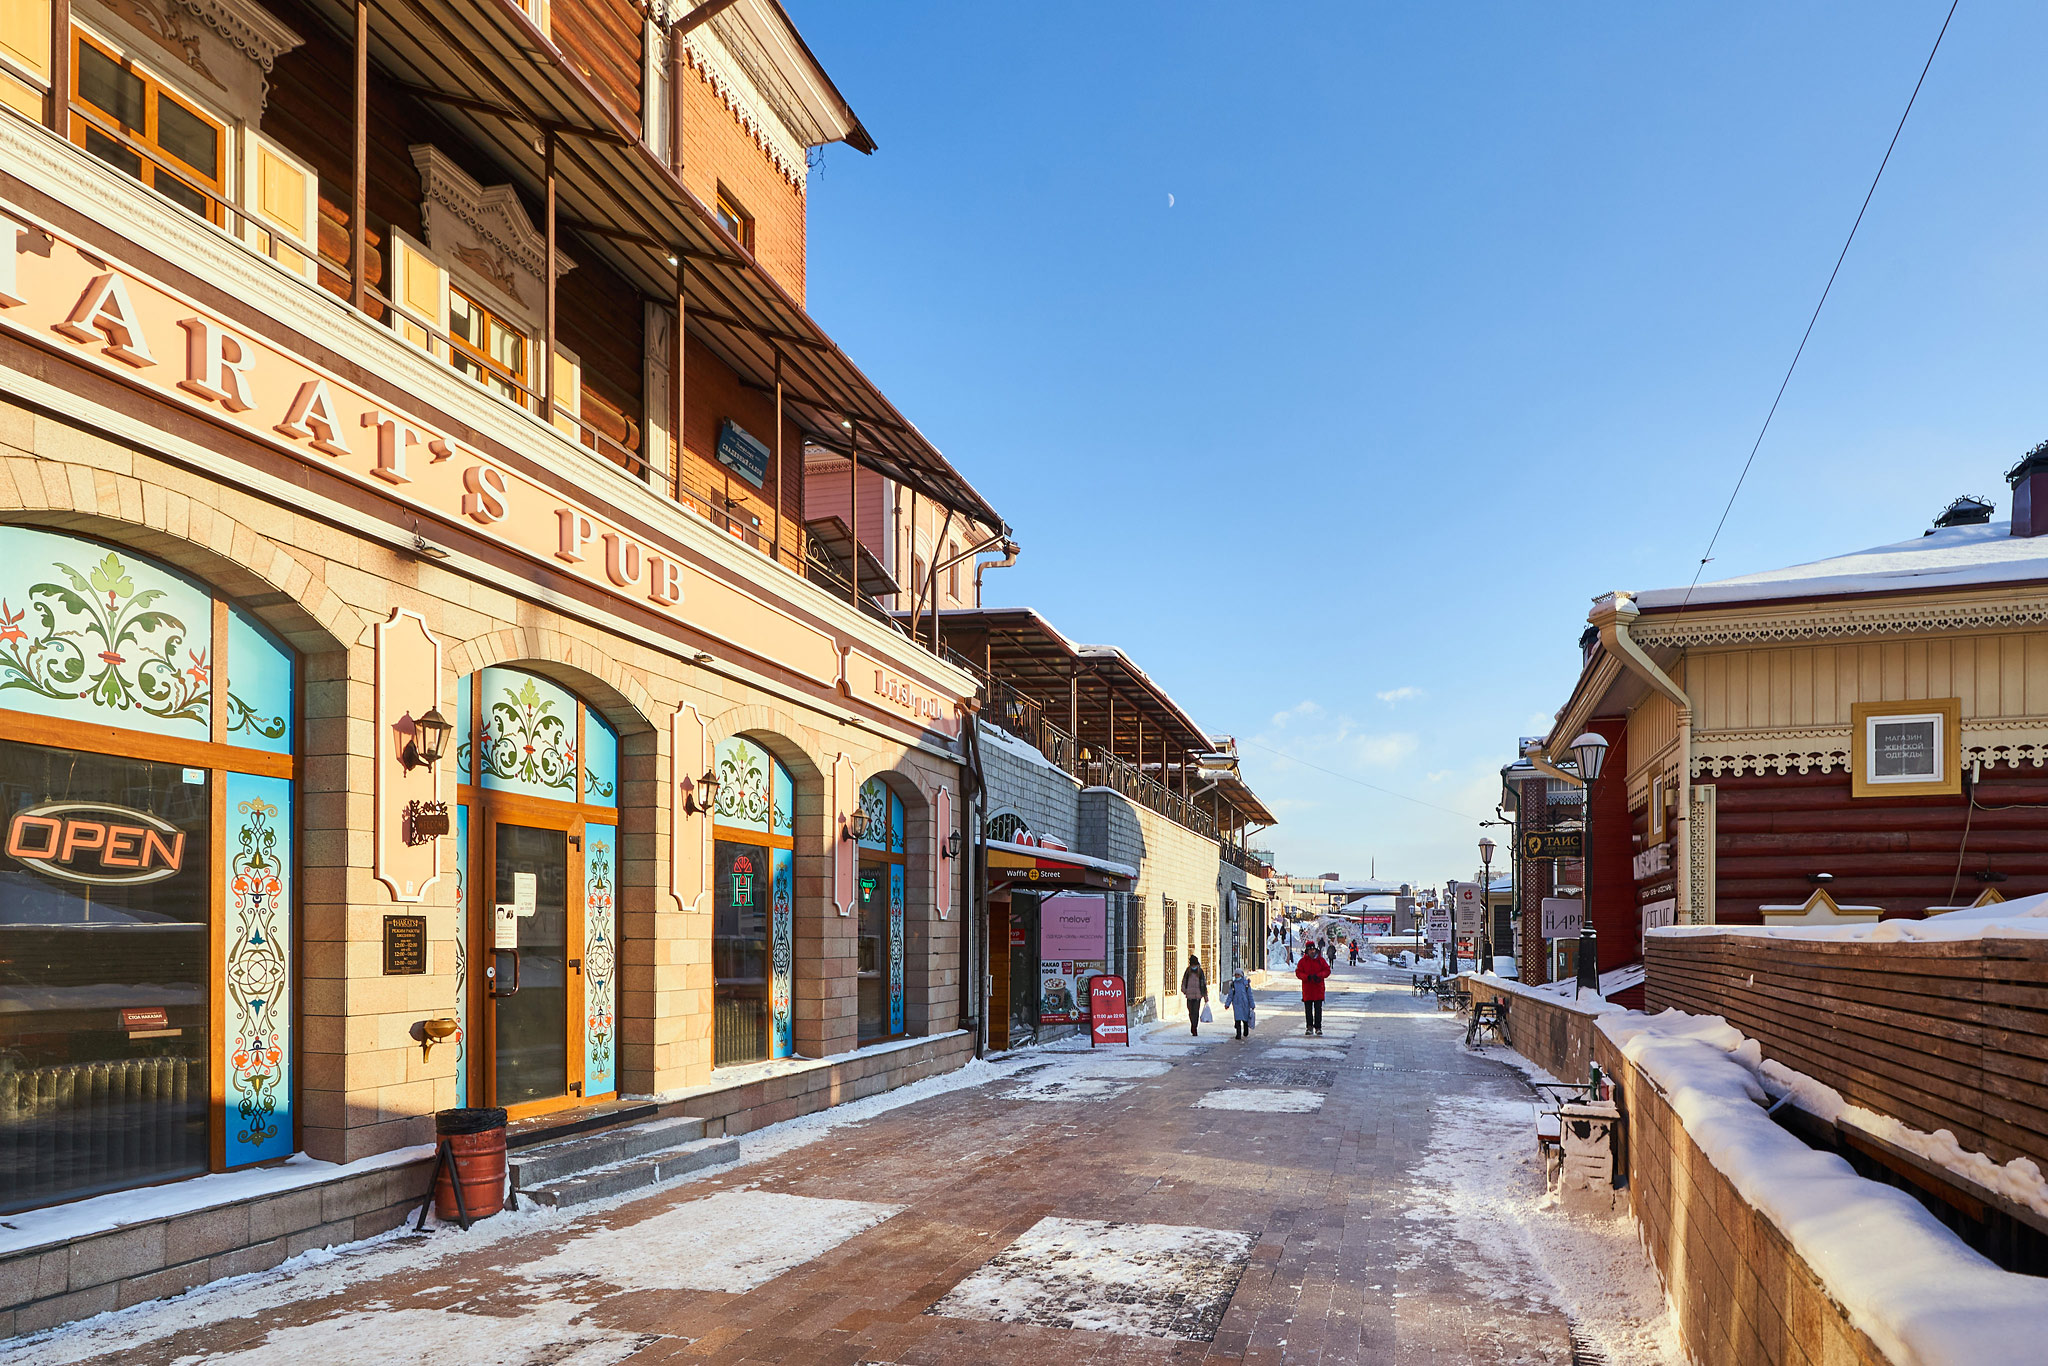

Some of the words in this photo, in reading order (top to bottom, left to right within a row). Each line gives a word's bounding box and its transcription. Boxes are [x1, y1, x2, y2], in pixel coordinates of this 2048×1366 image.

[554, 508, 684, 606] PUB
[874, 669, 916, 708] Irish
[914, 697, 943, 720] pub
[1885, 734, 1922, 742] МАГАЗИН
[1884, 742, 1924, 751] ЖЕНСКОЙ
[8, 815, 184, 870] OPEN
[1546, 836, 1579, 845] ТАИС
[1059, 915, 1090, 923] melove
[1092, 988, 1122, 998] Лямур
